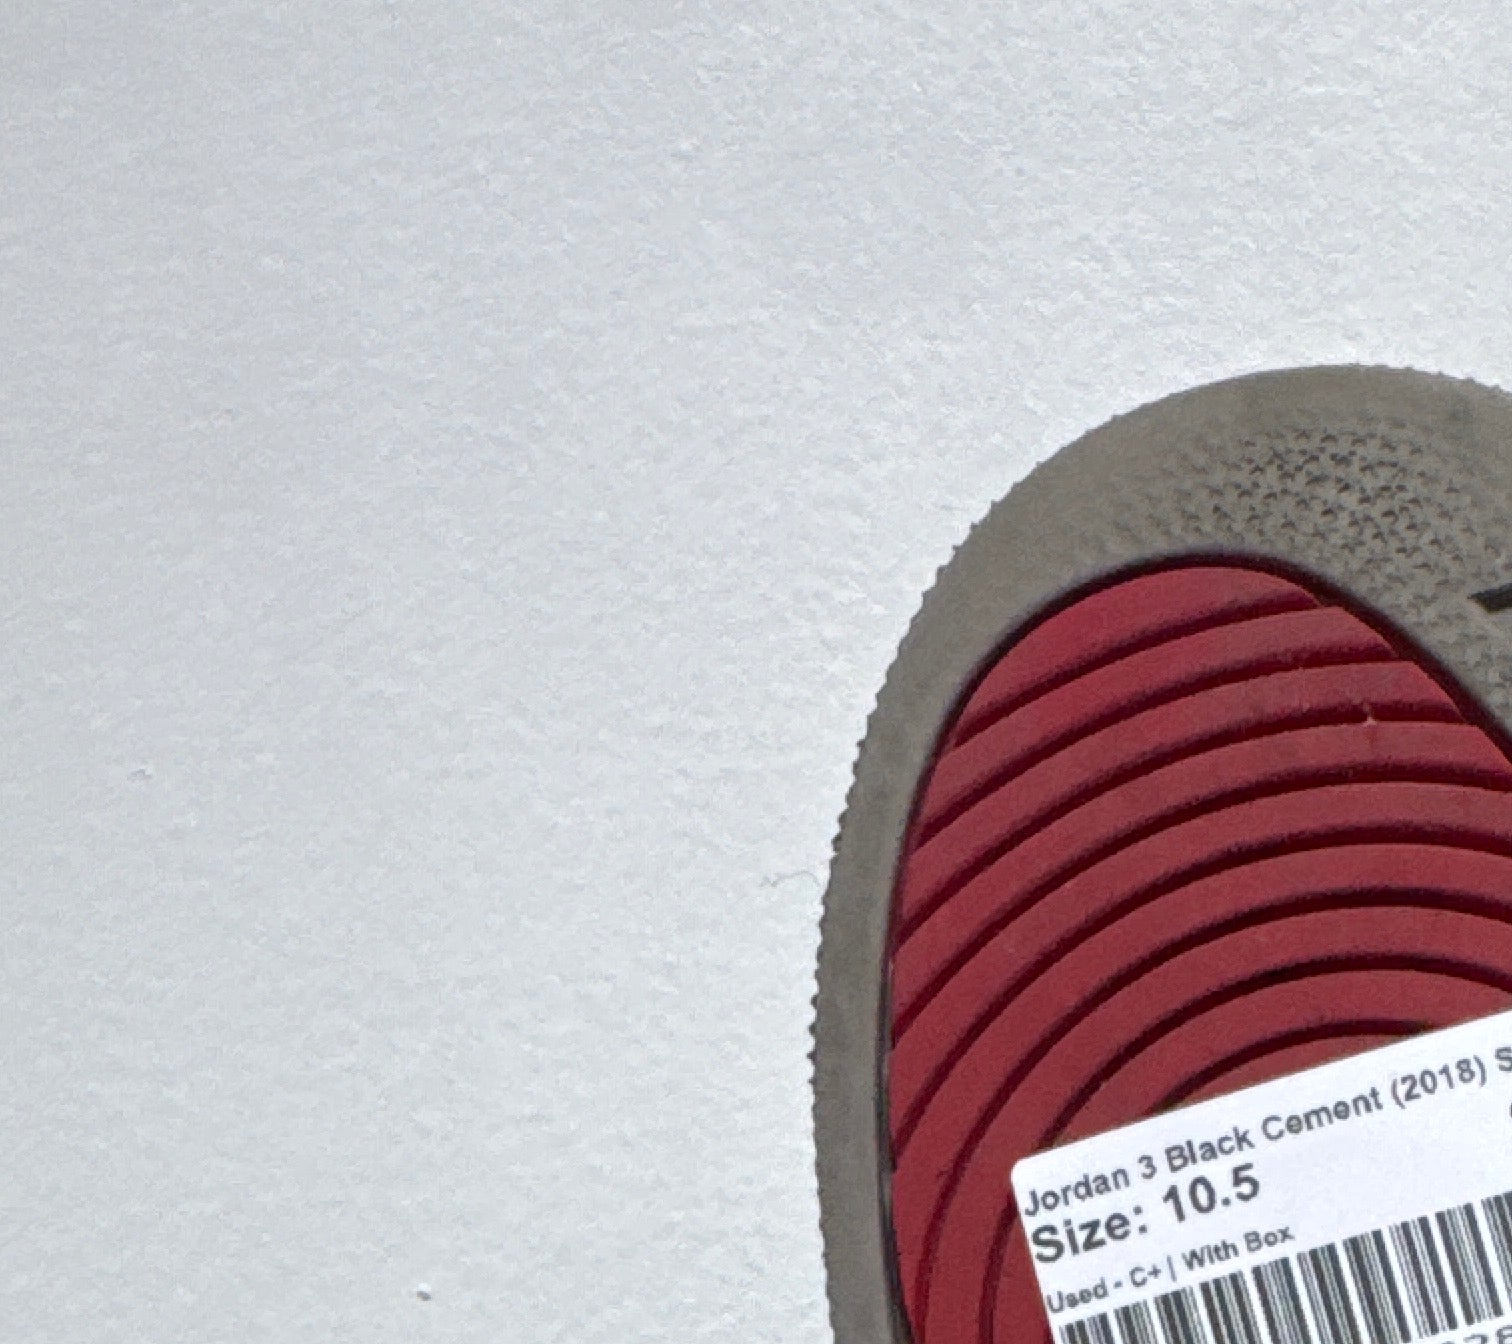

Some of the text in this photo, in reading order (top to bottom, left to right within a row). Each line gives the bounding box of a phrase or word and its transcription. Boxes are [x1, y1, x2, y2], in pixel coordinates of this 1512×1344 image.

[1024, 1167, 1130, 1217] Jordan
[1137, 1154, 1158, 1181] 3
[1165, 1126, 1255, 1173] Black
[1262, 1086, 1383, 1141] Cement
[1390, 1055, 1488, 1109] (2018)
[1032, 1162, 1260, 1263] Size: 10.5
[1046, 1276, 1109, 1314] Used
[1129, 1263, 1162, 1288] C+
[1182, 1240, 1240, 1271] With
[1243, 1226, 1295, 1253] Box
